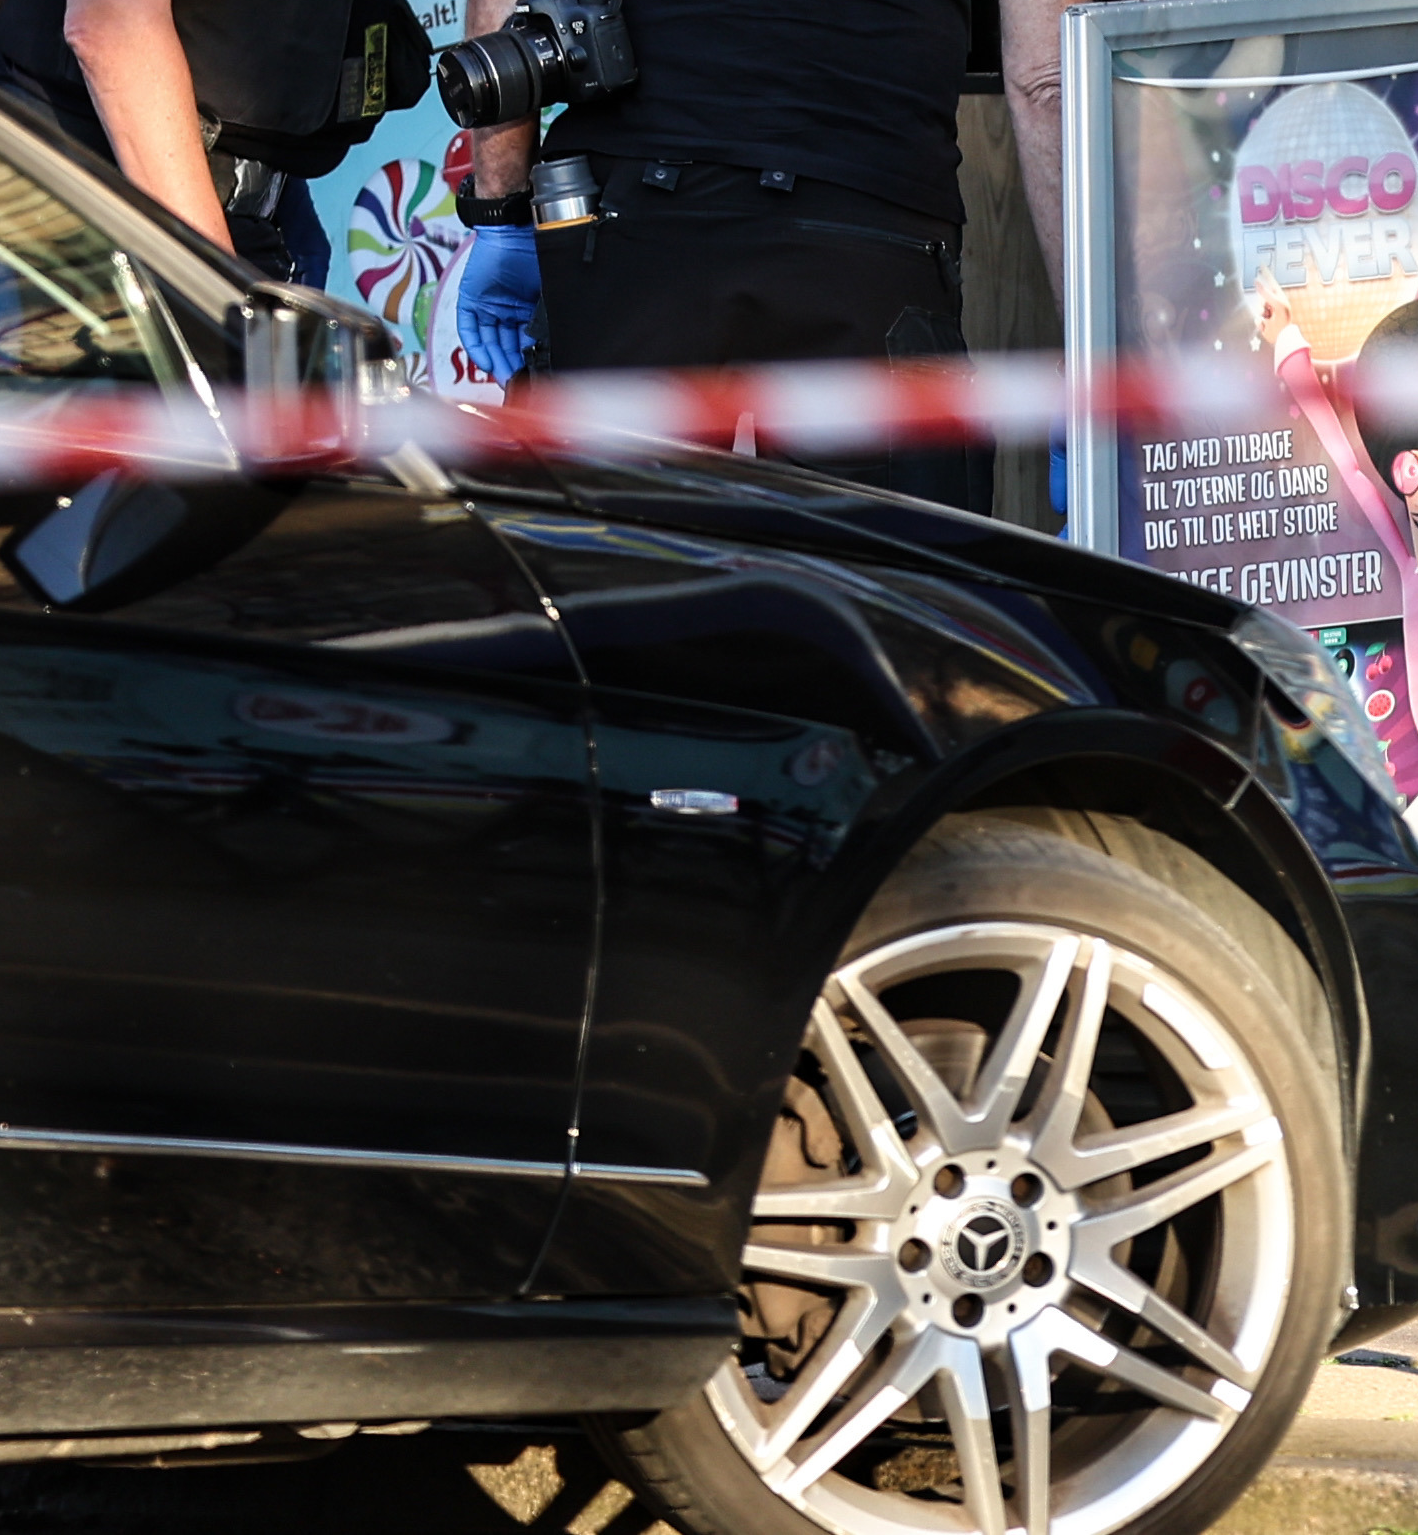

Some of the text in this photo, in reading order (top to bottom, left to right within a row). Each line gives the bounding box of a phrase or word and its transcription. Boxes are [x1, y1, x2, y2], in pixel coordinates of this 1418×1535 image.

[1237, 151, 1417, 228] DISCO
[1142, 430, 1293, 473] TAG MED TILBAGE
[1142, 480, 1169, 511] TIL
[1251, 470, 1275, 501] OG
[1280, 464, 1328, 499] DANS
[1144, 502, 1338, 551] DIG TIL DE HELT STORE
[1240, 550, 1382, 606] GEVINSTER
